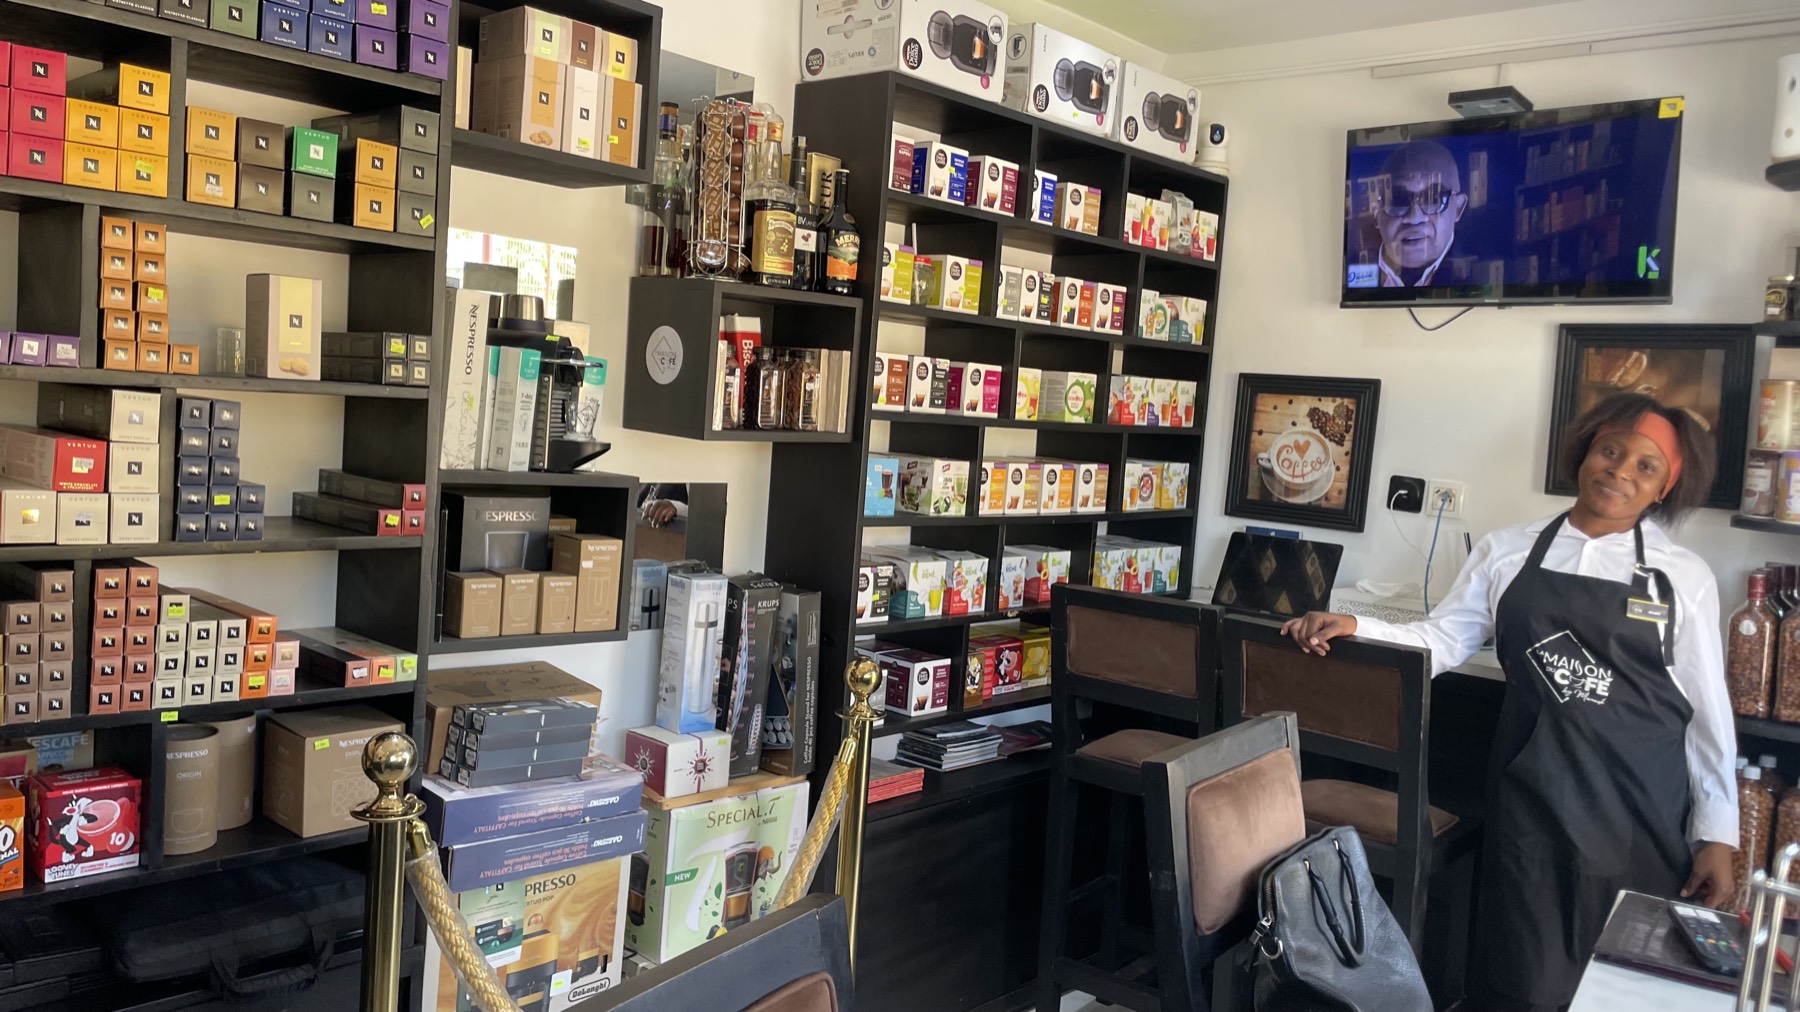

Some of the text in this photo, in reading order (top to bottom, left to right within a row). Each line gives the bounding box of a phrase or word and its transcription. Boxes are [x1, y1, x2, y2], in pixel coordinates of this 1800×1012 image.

[273, 7, 300, 18] VERTUO
[320, 19, 345, 30] VERTUO
[132, 69, 161, 79] VERTUO
[78, 103, 109, 113] VERTUO
[131, 113, 160, 122] VERTUO
[200, 111, 226, 120] VERTUO
[304, 132, 330, 140] VERTUO
[76, 146, 106, 155] VERTUO
[464, 304, 480, 376] NESPRESSO
[1276, 444, 1327, 483] Coffee
[588, 544, 617, 552] NESPRESSO
[758, 599, 780, 608] KRUPS
[1543, 652, 1612, 679] MAISON
[28, 734, 88, 750] ESCAFE
[176, 771, 202, 779] ORIGIN
[563, 809, 583, 820] Coffee
[472, 820, 507, 834] CAFFITALY
[110, 832, 126, 846] 10
[504, 854, 531, 866] capsules
[532, 850, 551, 861] coffee
[49, 863, 78, 874] LOONEY
[479, 866, 513, 878] CAFFITALY
[51, 871, 74, 879] TUNES
[674, 872, 691, 882] NEW
[524, 874, 577, 896] PRESSO
[572, 982, 607, 999] DeLonghi
